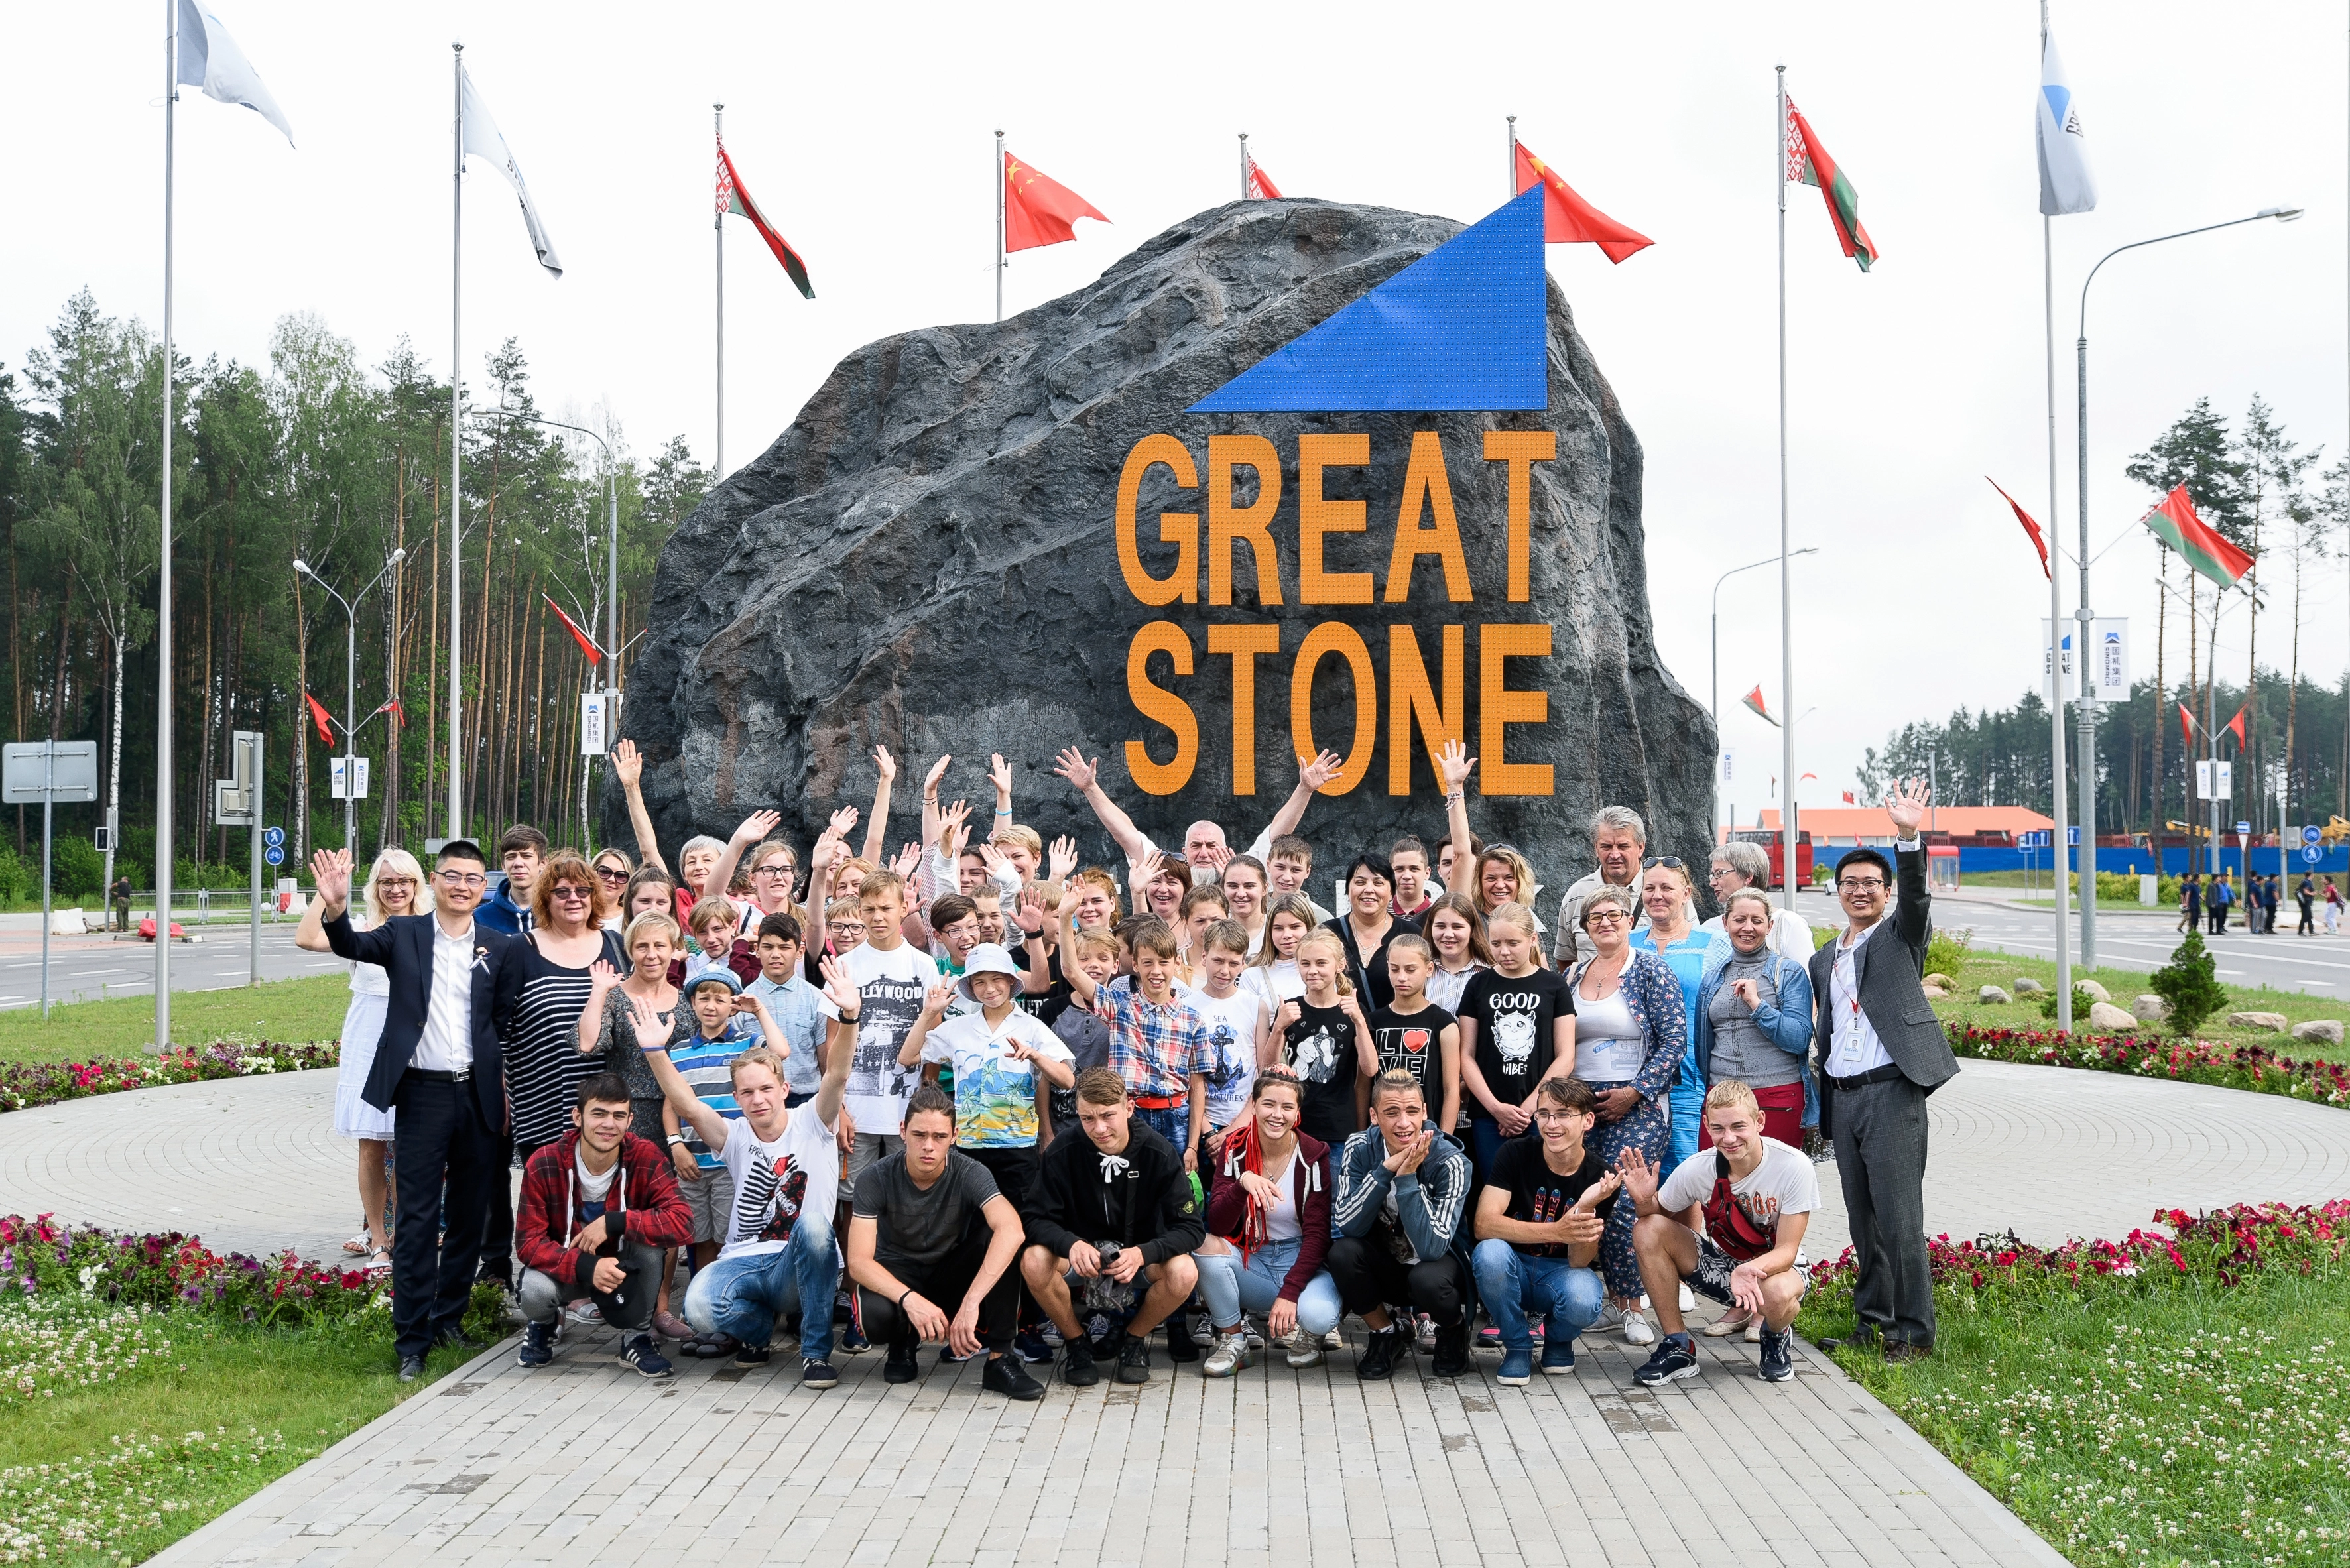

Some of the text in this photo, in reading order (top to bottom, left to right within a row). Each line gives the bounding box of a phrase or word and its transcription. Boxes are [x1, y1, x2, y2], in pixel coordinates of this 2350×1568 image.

[1115, 431, 1556, 606] GREAT
[2046, 653, 2070, 662] GAT
[1125, 621, 1554, 796] STONE
[861, 985, 923, 1000] LLYWOOD
[1489, 993, 1540, 1010] GOOD
[1205, 1093, 1243, 1102] VENTURES
